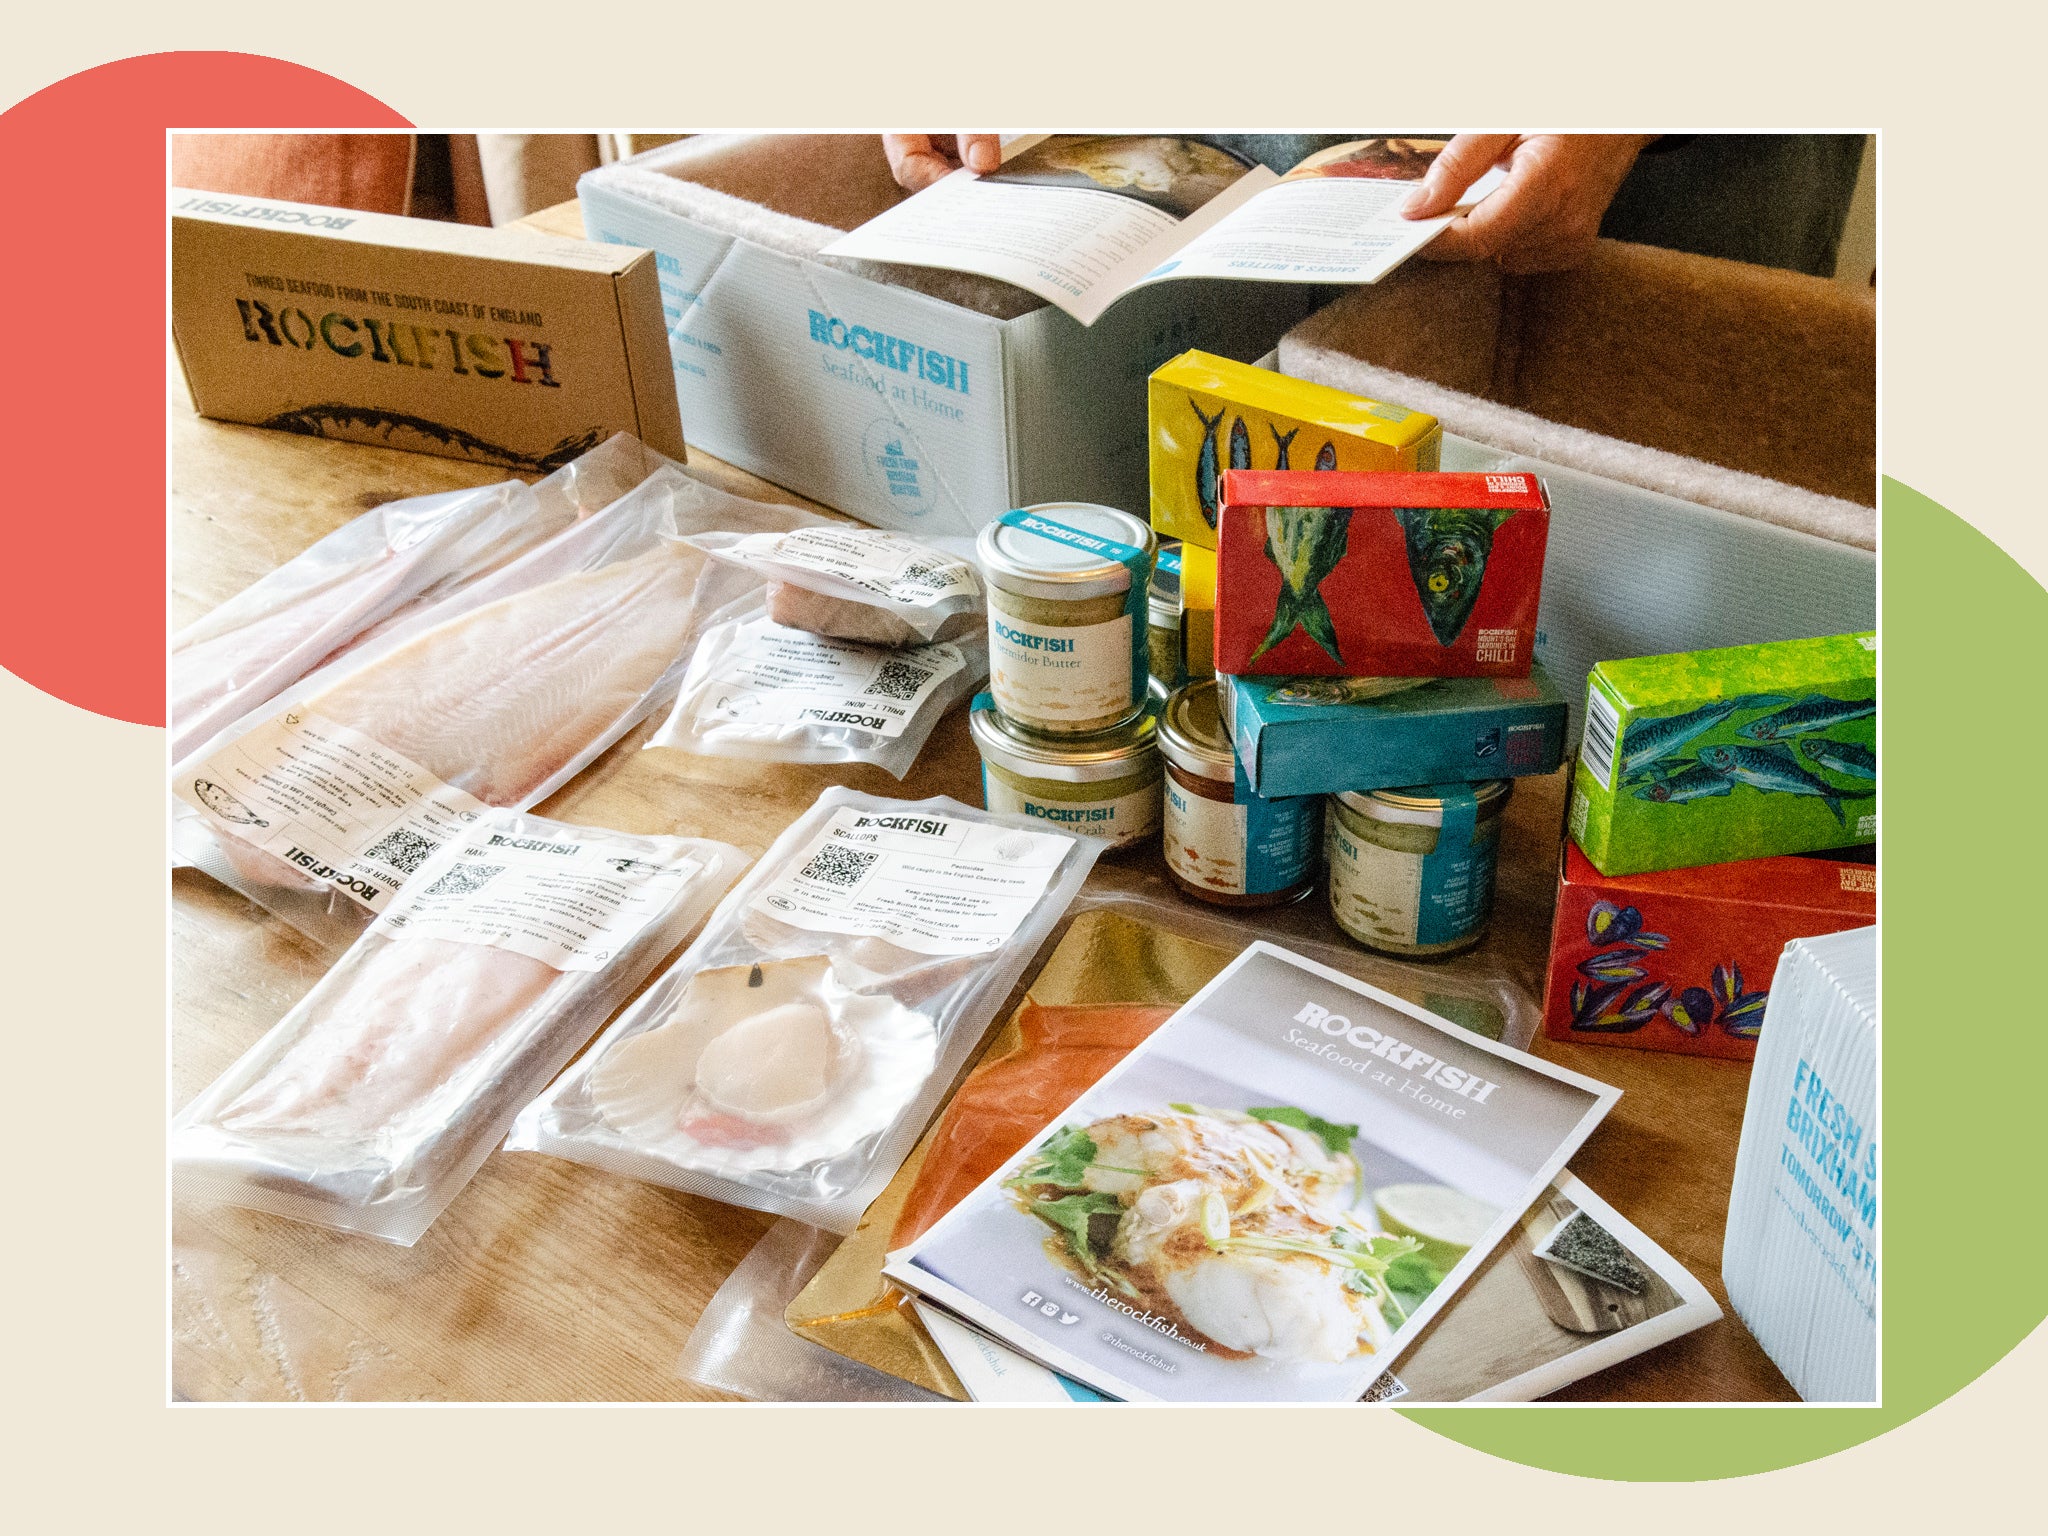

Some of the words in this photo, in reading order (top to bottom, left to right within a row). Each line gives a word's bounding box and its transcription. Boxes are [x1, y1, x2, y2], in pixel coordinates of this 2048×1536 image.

[178, 198, 357, 230] ROCKFISH
[245, 272, 285, 292] TINNED
[285, 278, 335, 299] SEAFOOD
[337, 286, 368, 302] FROM
[370, 290, 392, 307] THE
[394, 293, 432, 312] SOUTH
[434, 300, 469, 318] COAST
[472, 304, 487, 319] OF
[489, 306, 543, 327] ENGLAND
[1037, 269, 1083, 298] BUTTERS
[235, 298, 561, 388] ROCKFISH
[808, 308, 970, 395] ROCKFISH
[822, 353, 886, 394] Seafood
[891, 384, 906, 401] at
[911, 385, 964, 422] Home
[1019, 518, 1107, 550] ROCKFISH
[995, 620, 1075, 653] ROCKFISH
[1042, 655, 1082, 669] Butter
[1476, 649, 1515, 662] CHILLI
[882, 705, 906, 716] BRILL
[313, 800, 337, 816] Caught
[1024, 802, 1115, 822] ROCKFISH
[833, 827, 879, 843] SCALLOPS
[854, 816, 949, 837] ROCKFISH
[487, 834, 582, 856] ROCKFISH
[284, 846, 380, 902] ROCKFISH
[594, 892, 621, 906] Ladram
[811, 894, 831, 902] shell
[922, 891, 961, 901] refrigerated
[543, 920, 588, 941] CRUSTACEAN
[1292, 1001, 1501, 1105] ROCKFISH
[1282, 1028, 1373, 1074] Seafood
[1371, 1070, 1396, 1087] at
[1398, 1079, 1466, 1120] Home
[1793, 1057, 1862, 1160] FRESH
[1781, 1142, 1864, 1261] TOMORROW'S
[1064, 1276, 1208, 1353] www.therockfish.co.uk
[1101, 1332, 1177, 1375] @therockfishuk
